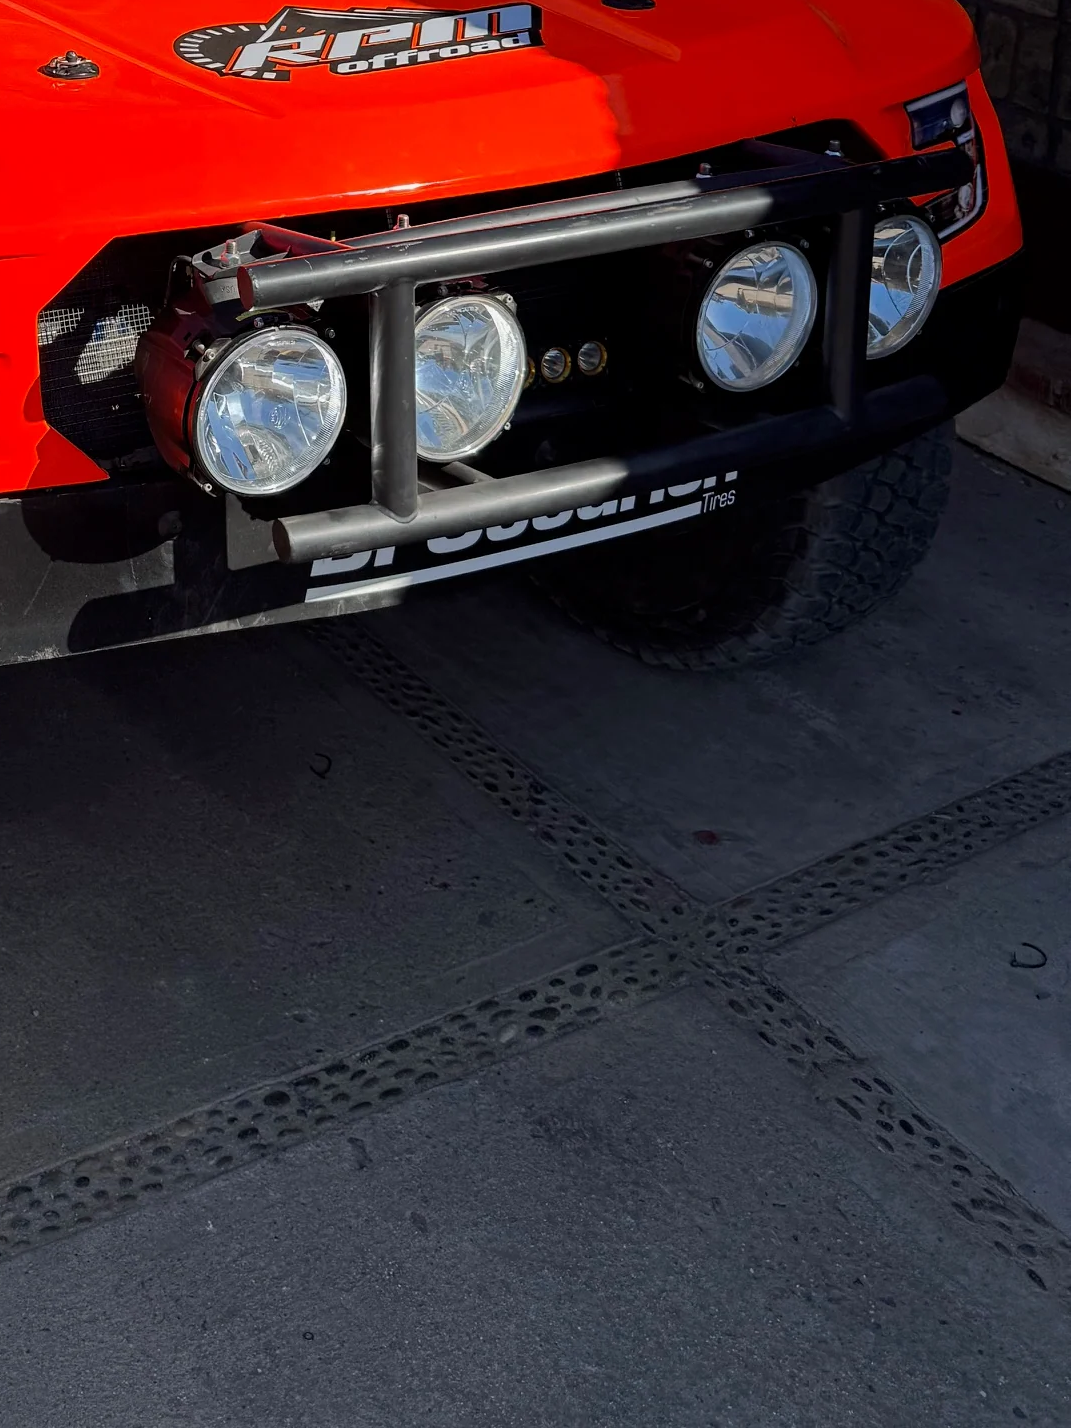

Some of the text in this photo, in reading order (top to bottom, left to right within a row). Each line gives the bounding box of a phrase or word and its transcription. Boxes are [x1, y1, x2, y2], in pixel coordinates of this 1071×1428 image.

[227, 4, 533, 72] RPM
[337, 29, 532, 74] offroad
[701, 488, 736, 514] Tires
